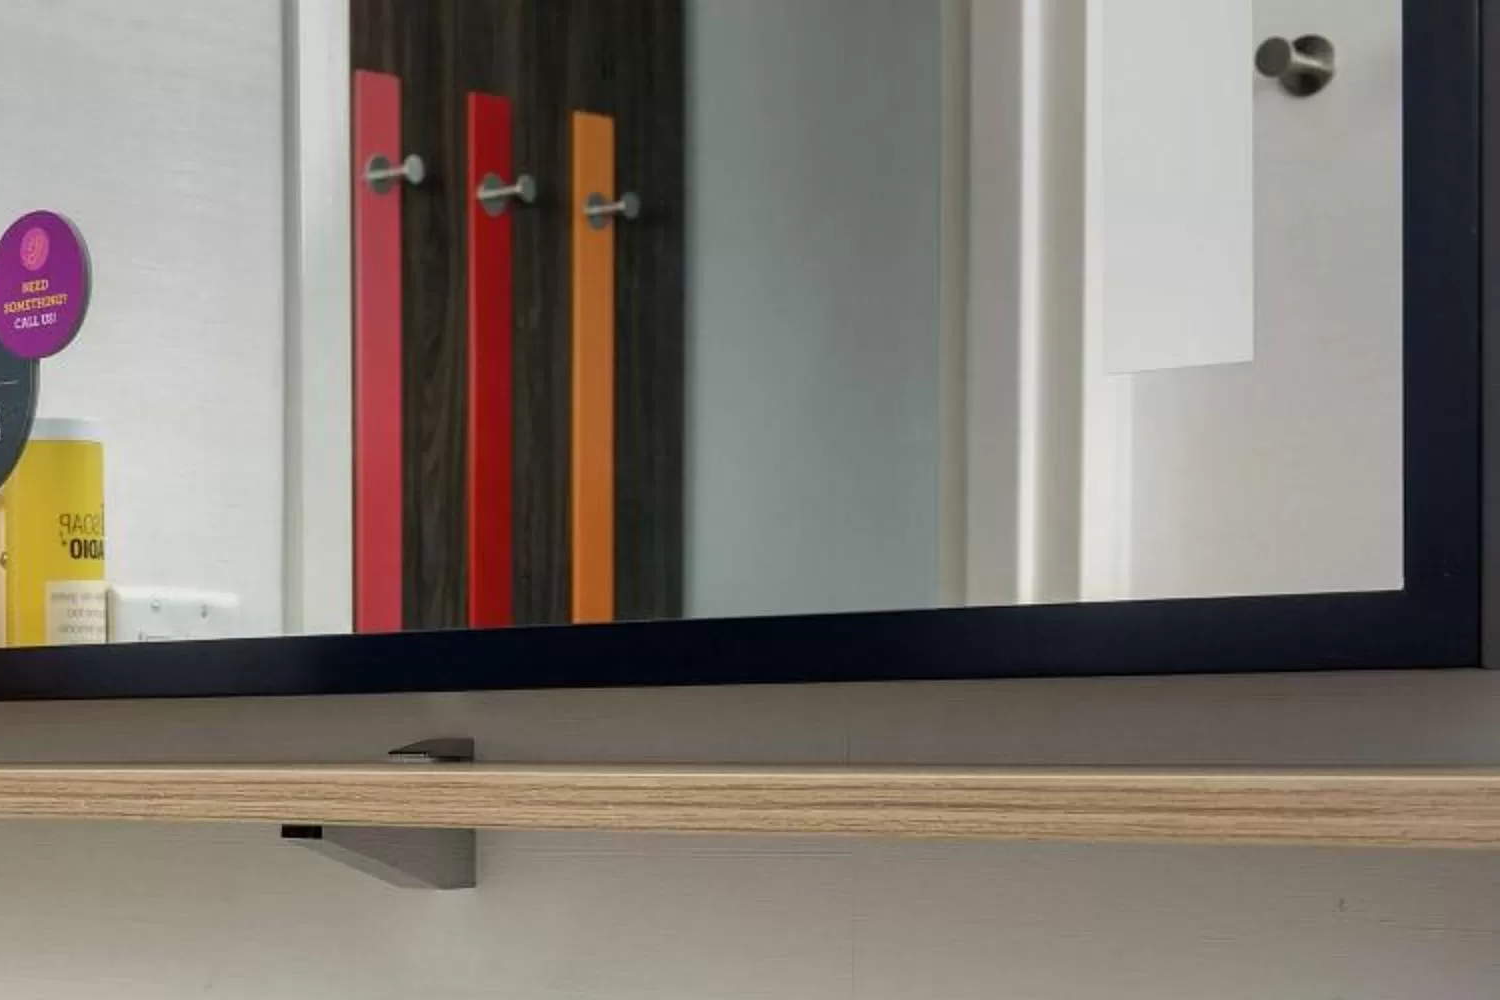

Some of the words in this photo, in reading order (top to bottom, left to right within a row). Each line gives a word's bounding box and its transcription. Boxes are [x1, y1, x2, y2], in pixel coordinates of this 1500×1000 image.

[21, 279, 49, 293] NEED
[3, 293, 68, 315] SOMETHING?
[13, 315, 40, 329] CALL
